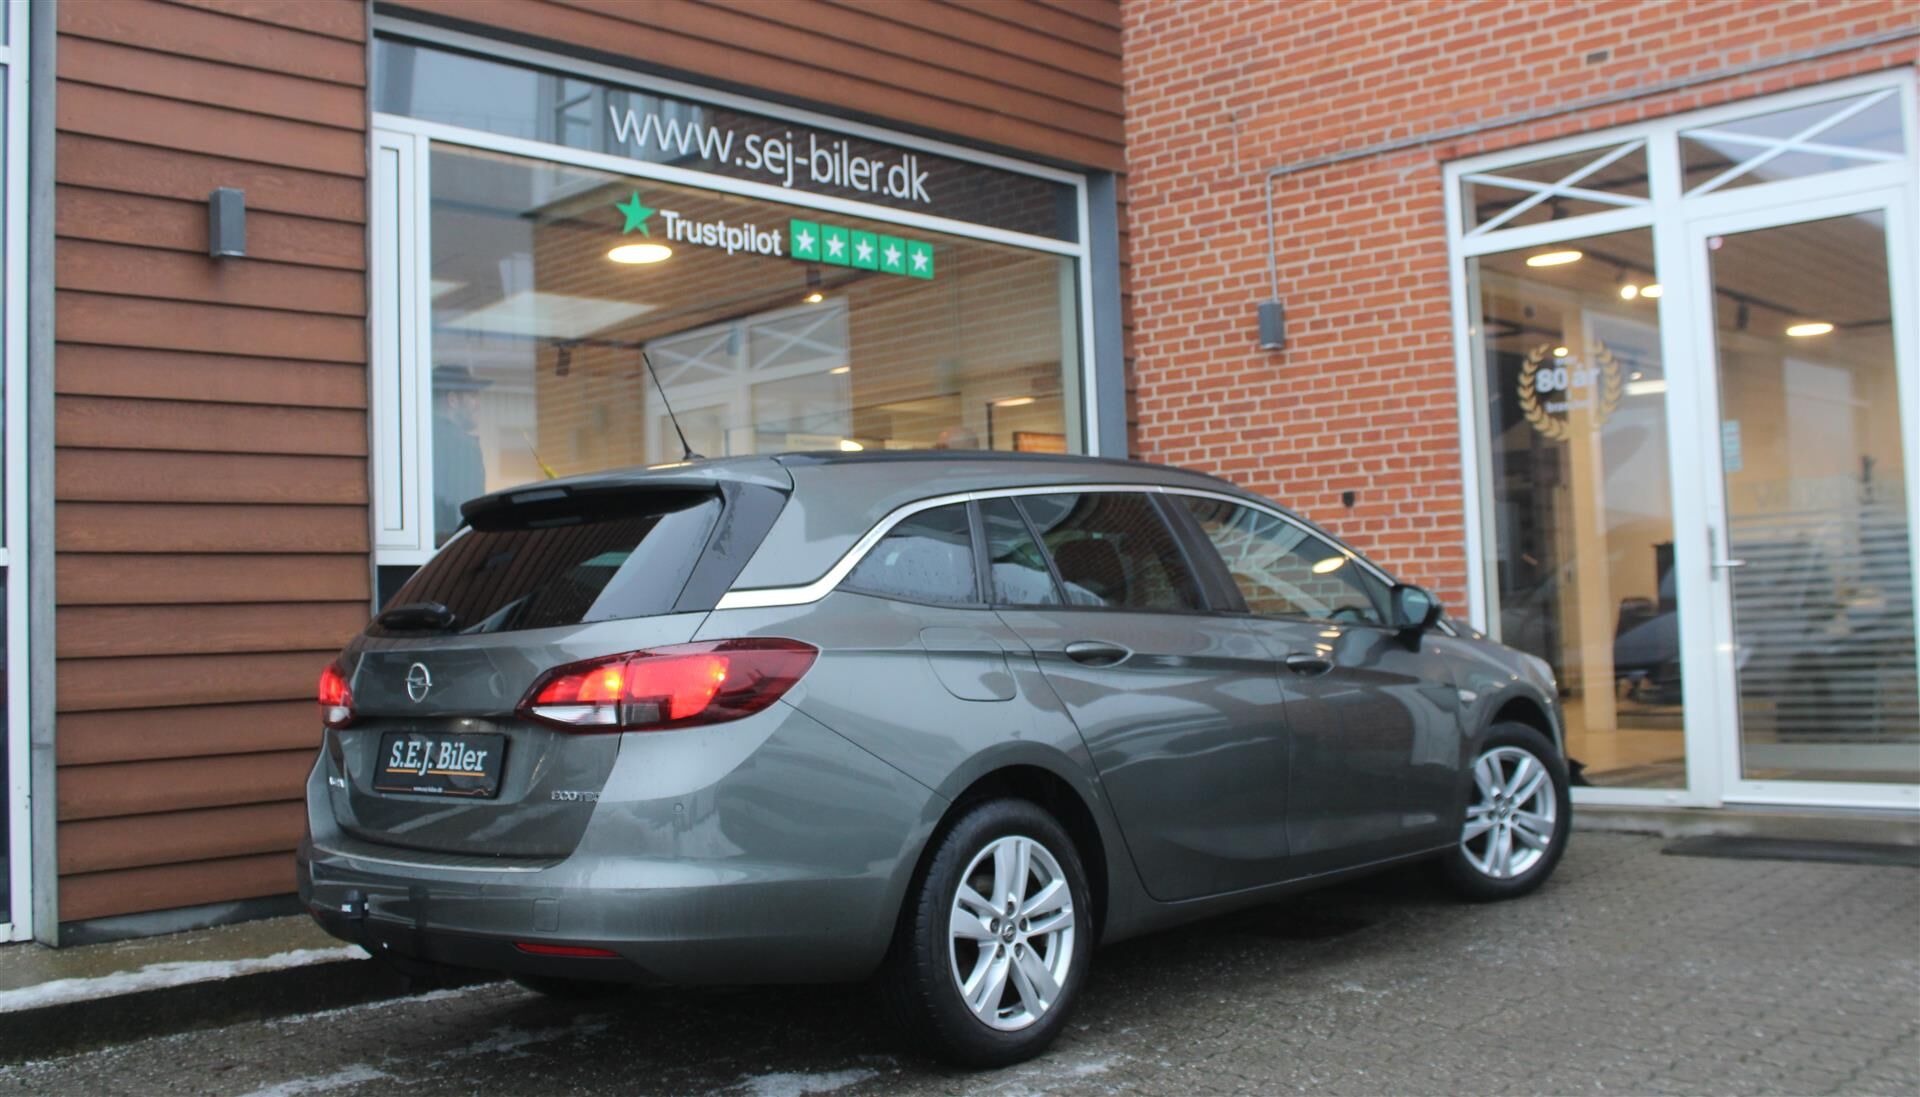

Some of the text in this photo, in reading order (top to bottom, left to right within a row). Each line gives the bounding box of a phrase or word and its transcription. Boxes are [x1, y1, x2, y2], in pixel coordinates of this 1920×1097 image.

[609, 104, 932, 203] www.sej-biler.dk
[660, 209, 783, 256] Trustpilot
[1535, 367, 1568, 393] 80
[389, 740, 488, 776] S.E.J. Biler
